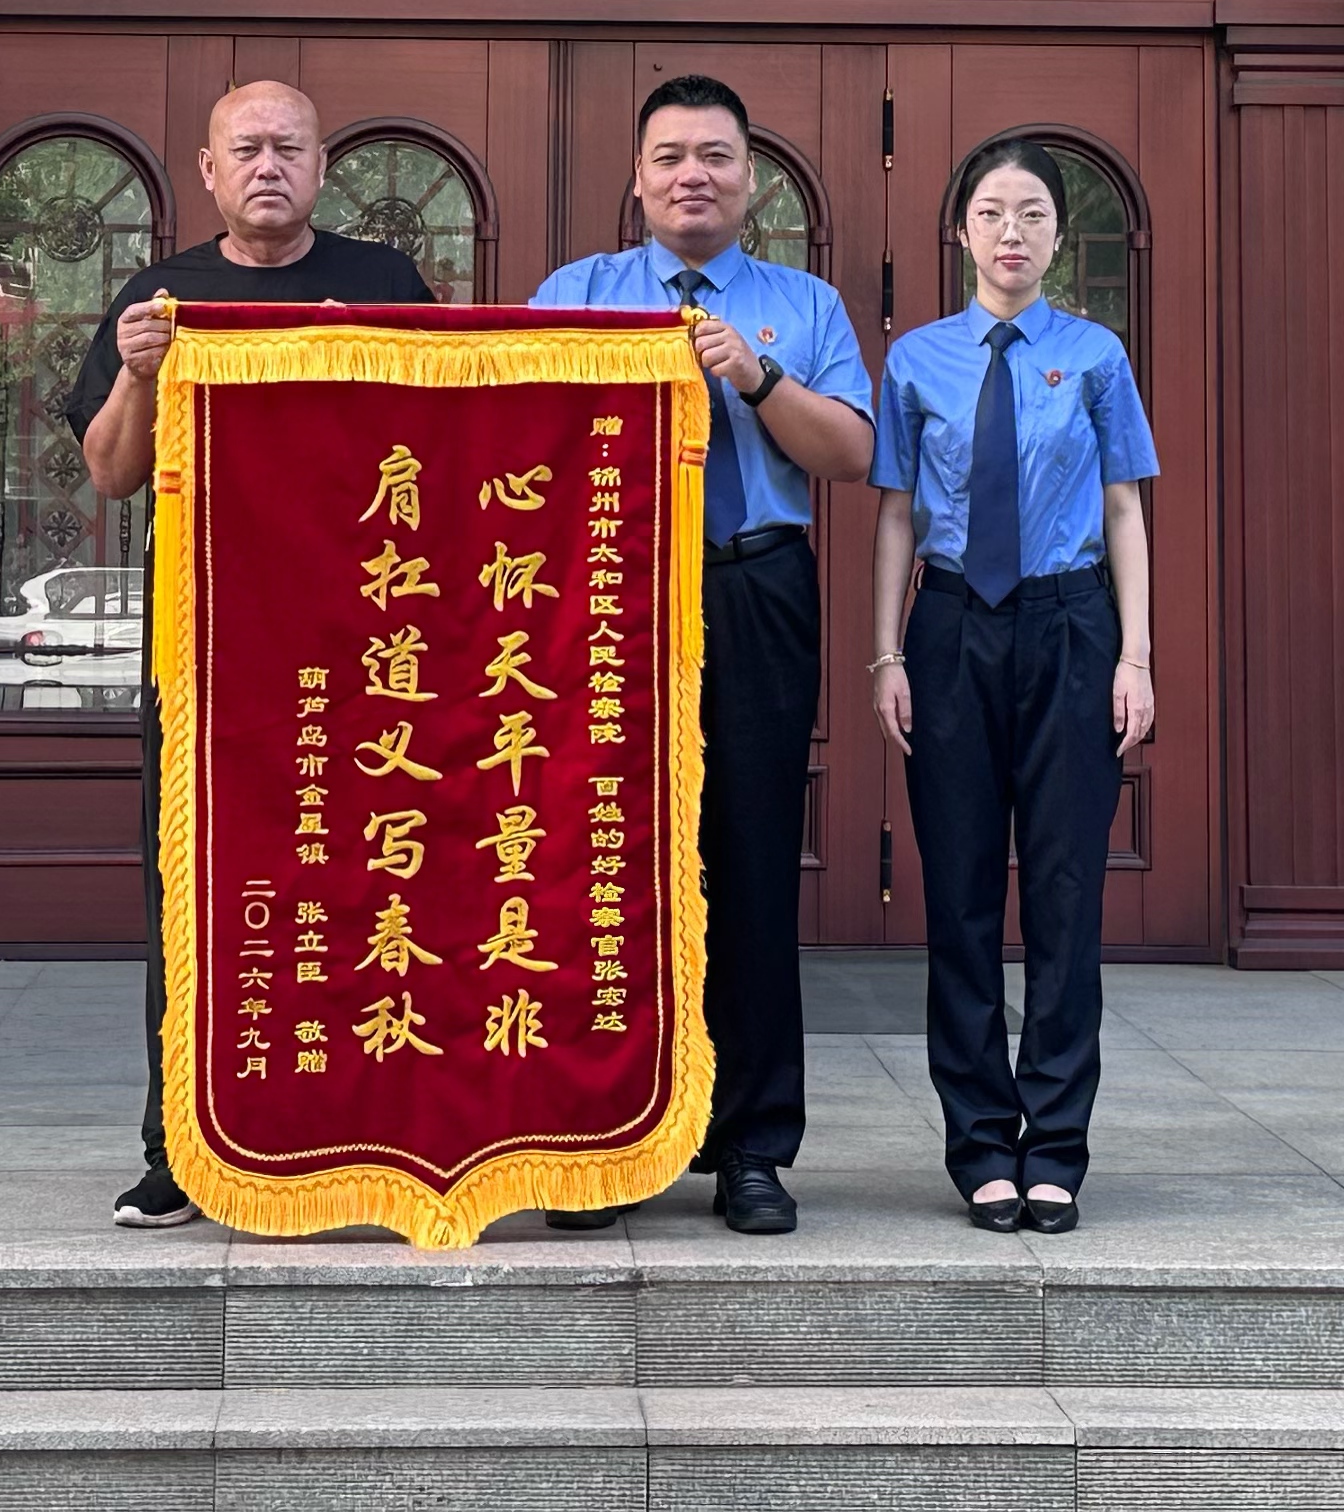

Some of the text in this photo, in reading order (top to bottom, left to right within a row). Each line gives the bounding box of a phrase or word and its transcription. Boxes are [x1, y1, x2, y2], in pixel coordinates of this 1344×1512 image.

[293, 666, 331, 1074] 葫芦岛市金星镇 张立臣 敬赠
[351, 444, 445, 1064] 肩扛道义写春秋
[475, 464, 561, 1060] 心怀天平量是非
